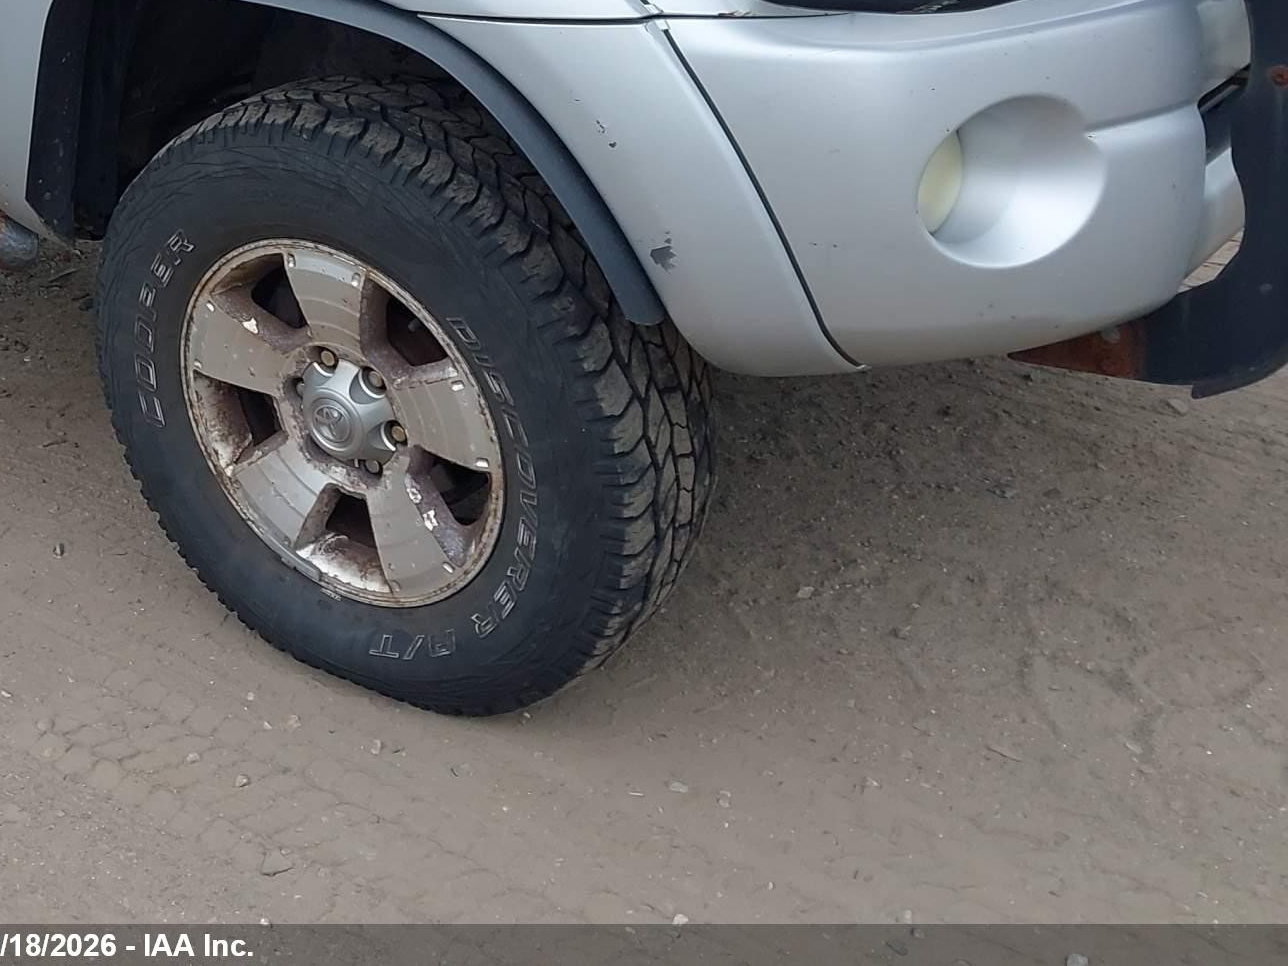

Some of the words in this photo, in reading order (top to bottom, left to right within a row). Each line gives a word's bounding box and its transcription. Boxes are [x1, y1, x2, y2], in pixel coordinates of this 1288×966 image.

[134, 228, 196, 428] COOPER
[446, 315, 540, 639] DISCOVERER
[369, 628, 457, 660] A/T
